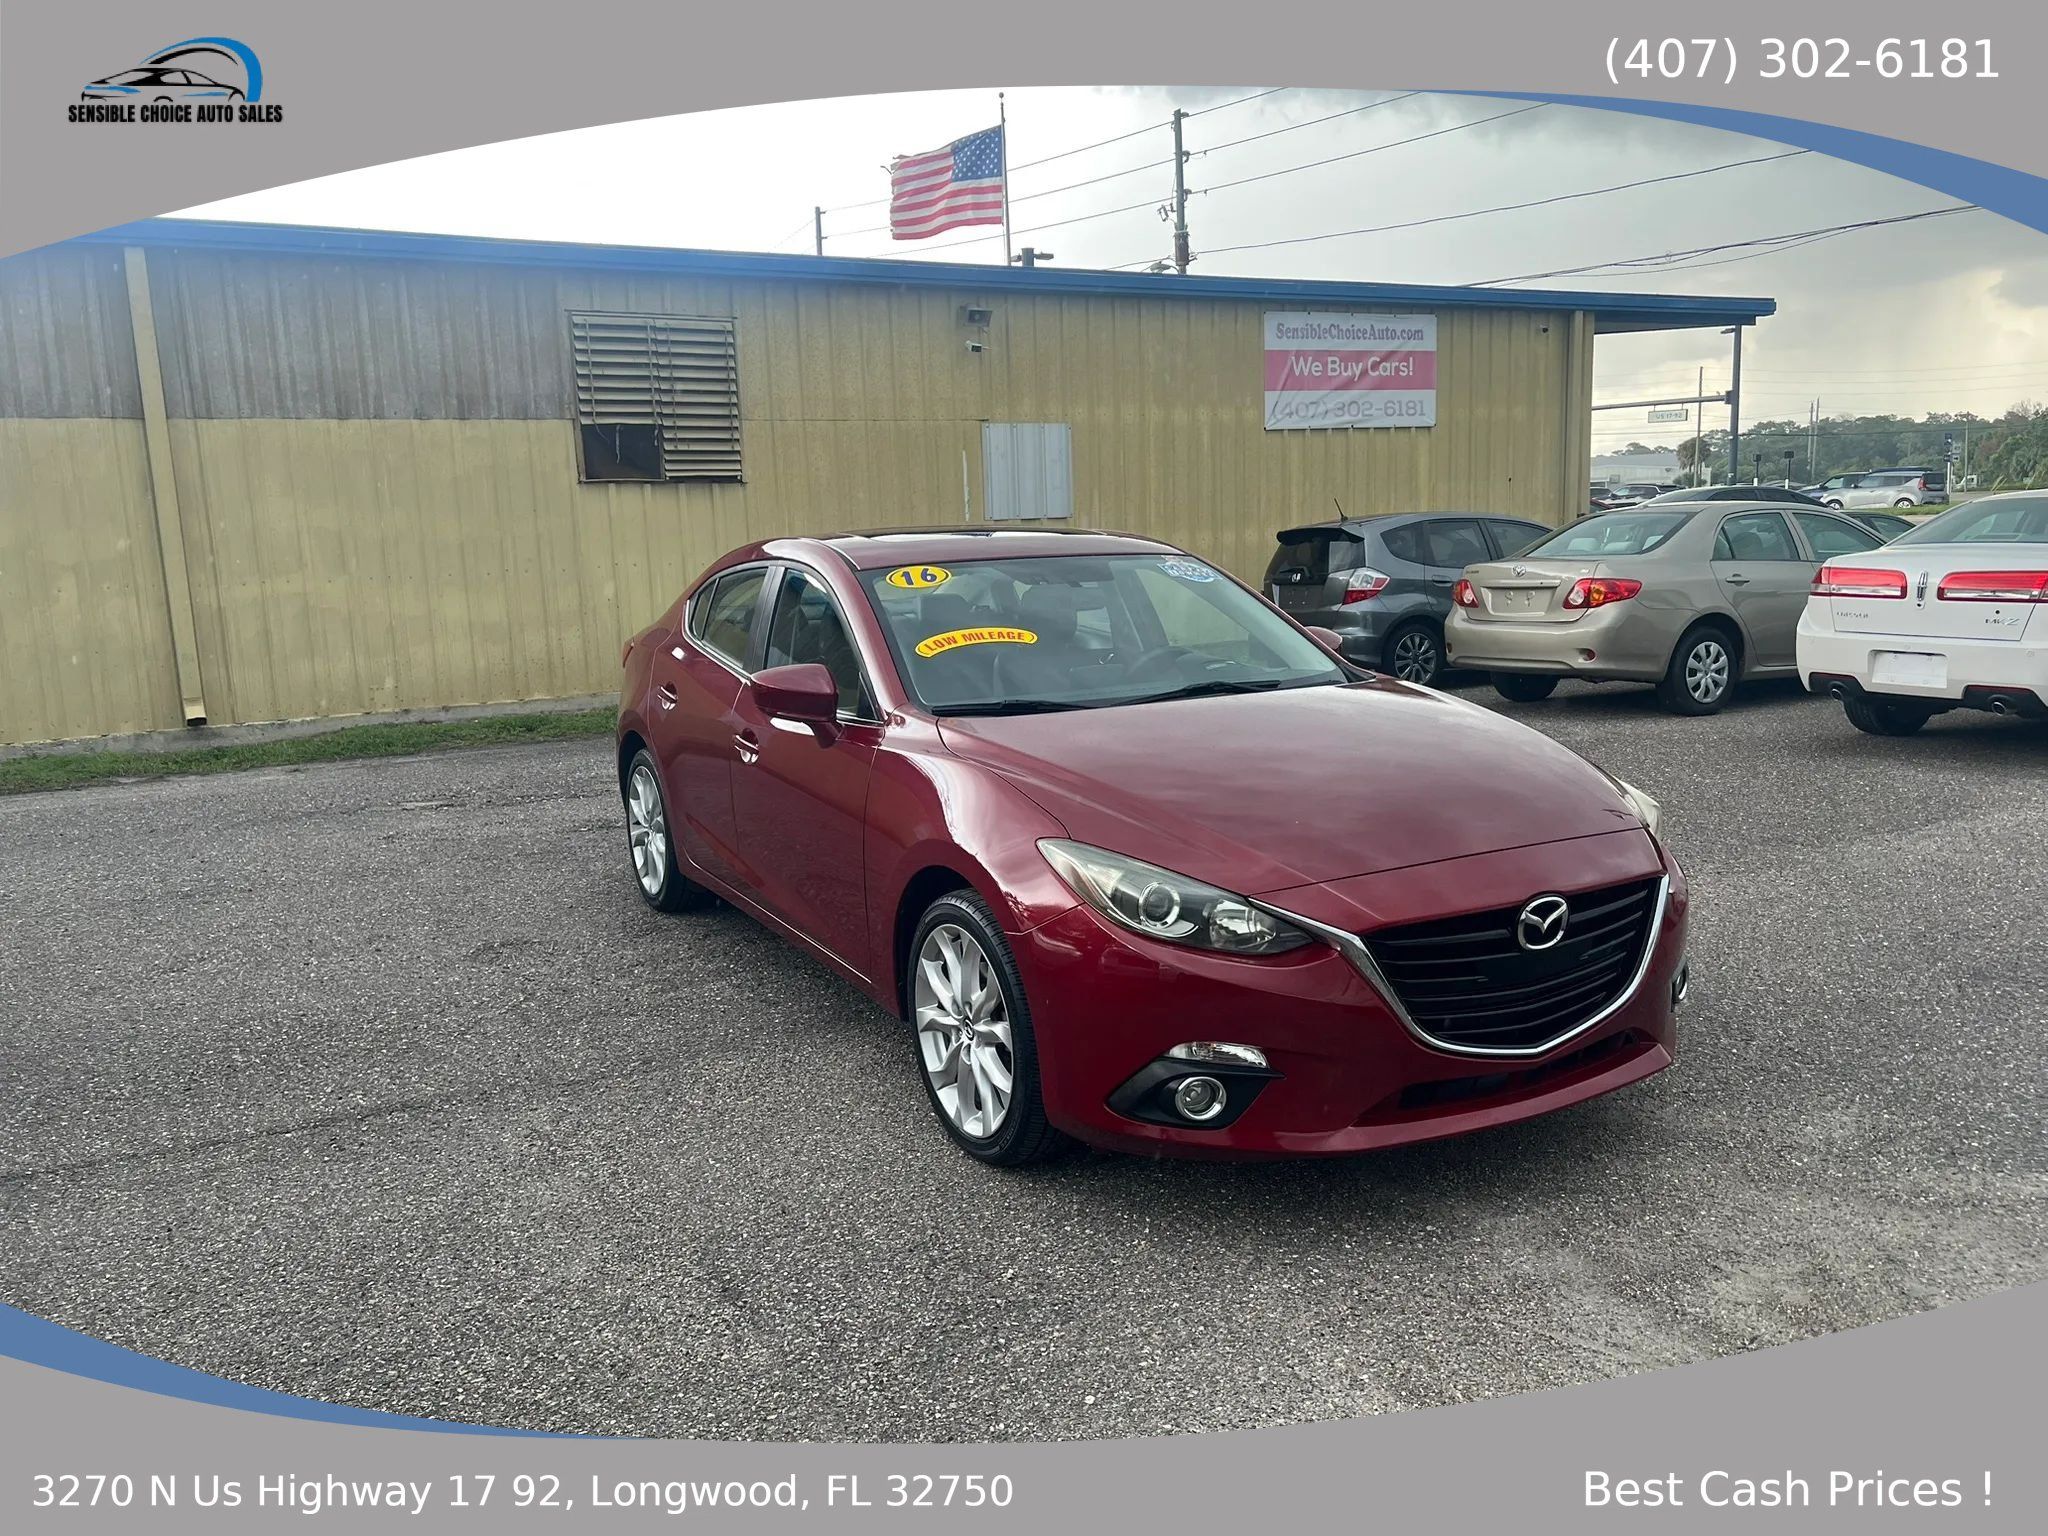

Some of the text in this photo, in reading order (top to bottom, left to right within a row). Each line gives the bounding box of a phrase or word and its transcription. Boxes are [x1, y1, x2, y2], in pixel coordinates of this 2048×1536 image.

[1276, 322, 1424, 341] SensibleChoiceAuto.com
[1292, 356, 1414, 381] We Buy Cars!
[1272, 400, 1426, 420] (407) 302-6181
[901, 568, 938, 586] 16
[923, 631, 1025, 652] LOW MILEAGE
